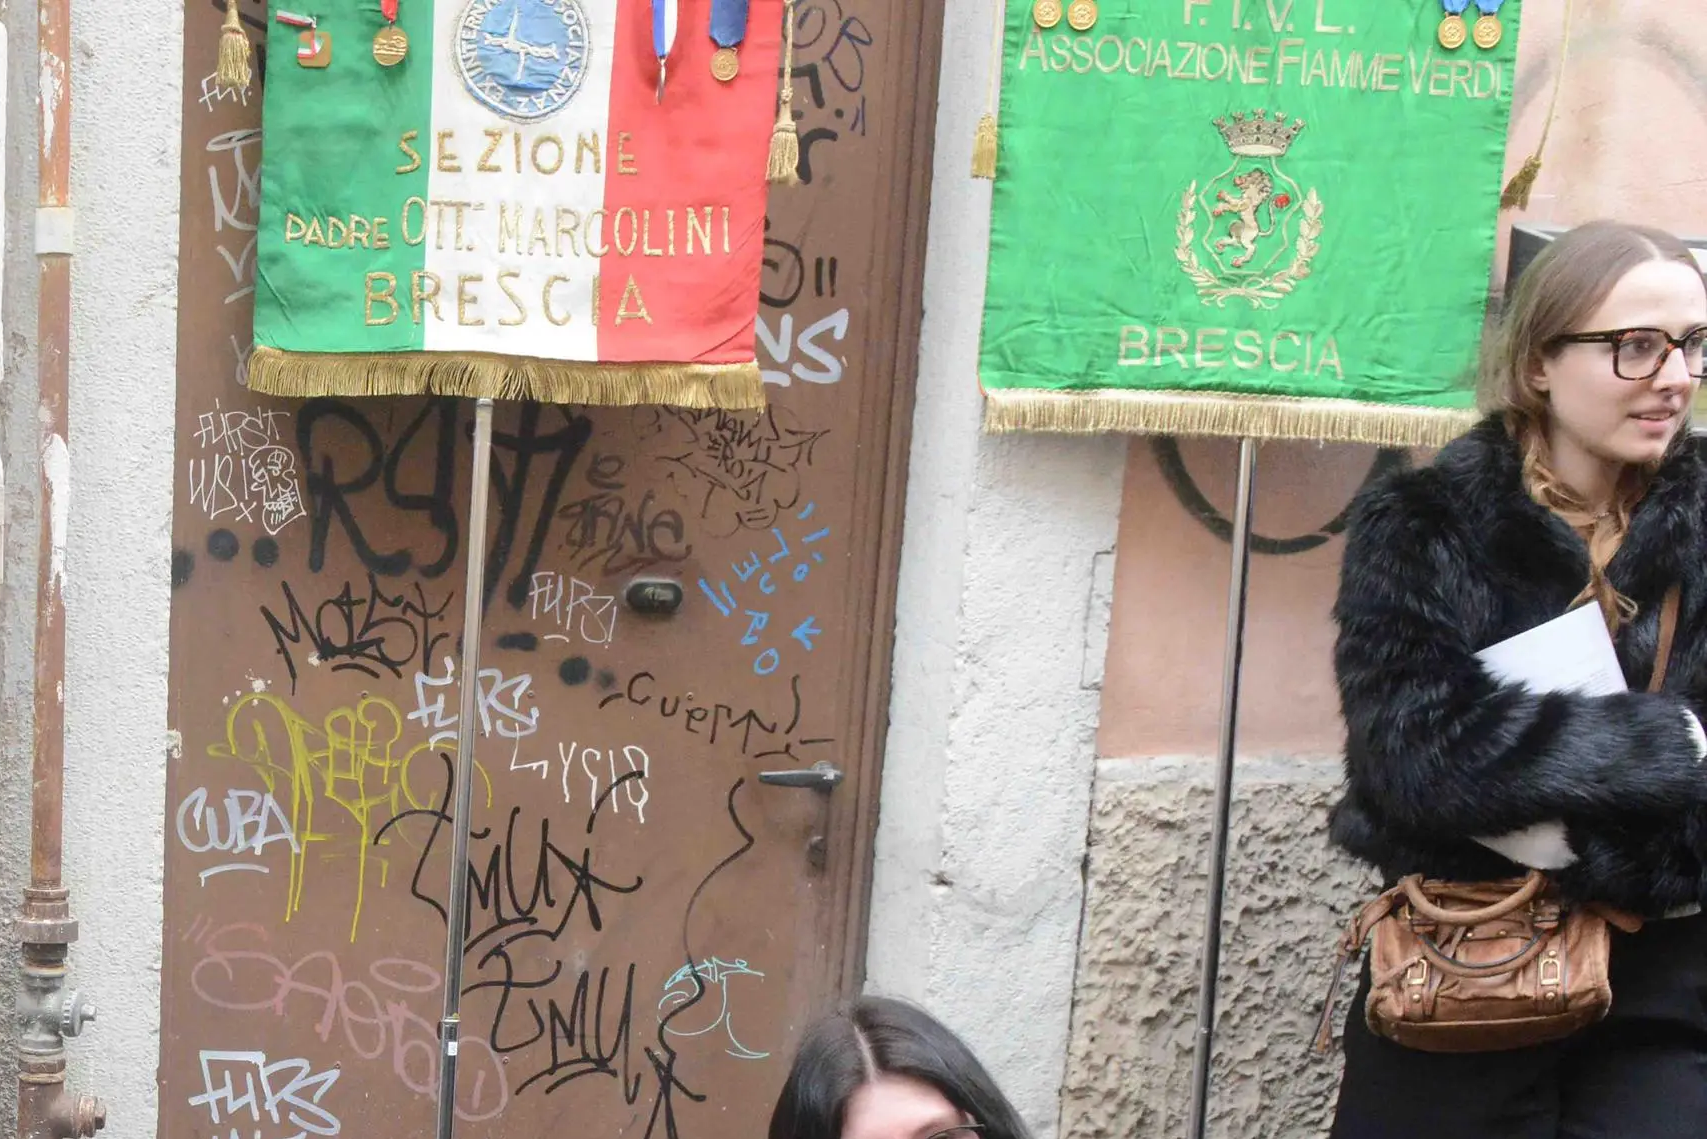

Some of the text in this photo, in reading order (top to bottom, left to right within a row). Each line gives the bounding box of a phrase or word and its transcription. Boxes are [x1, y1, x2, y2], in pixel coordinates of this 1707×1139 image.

[1018, 29, 1271, 85] ASSOCIAZIONE
[1276, 38, 1404, 91] FIAMME
[395, 129, 638, 175] SEZIONE
[284, 213, 391, 250] PADRE
[497, 201, 731, 258] MARCOLINI
[364, 270, 655, 327] BRESCIA
[1117, 324, 1345, 380] BRESCIA
[177, 786, 301, 856] CUBA
